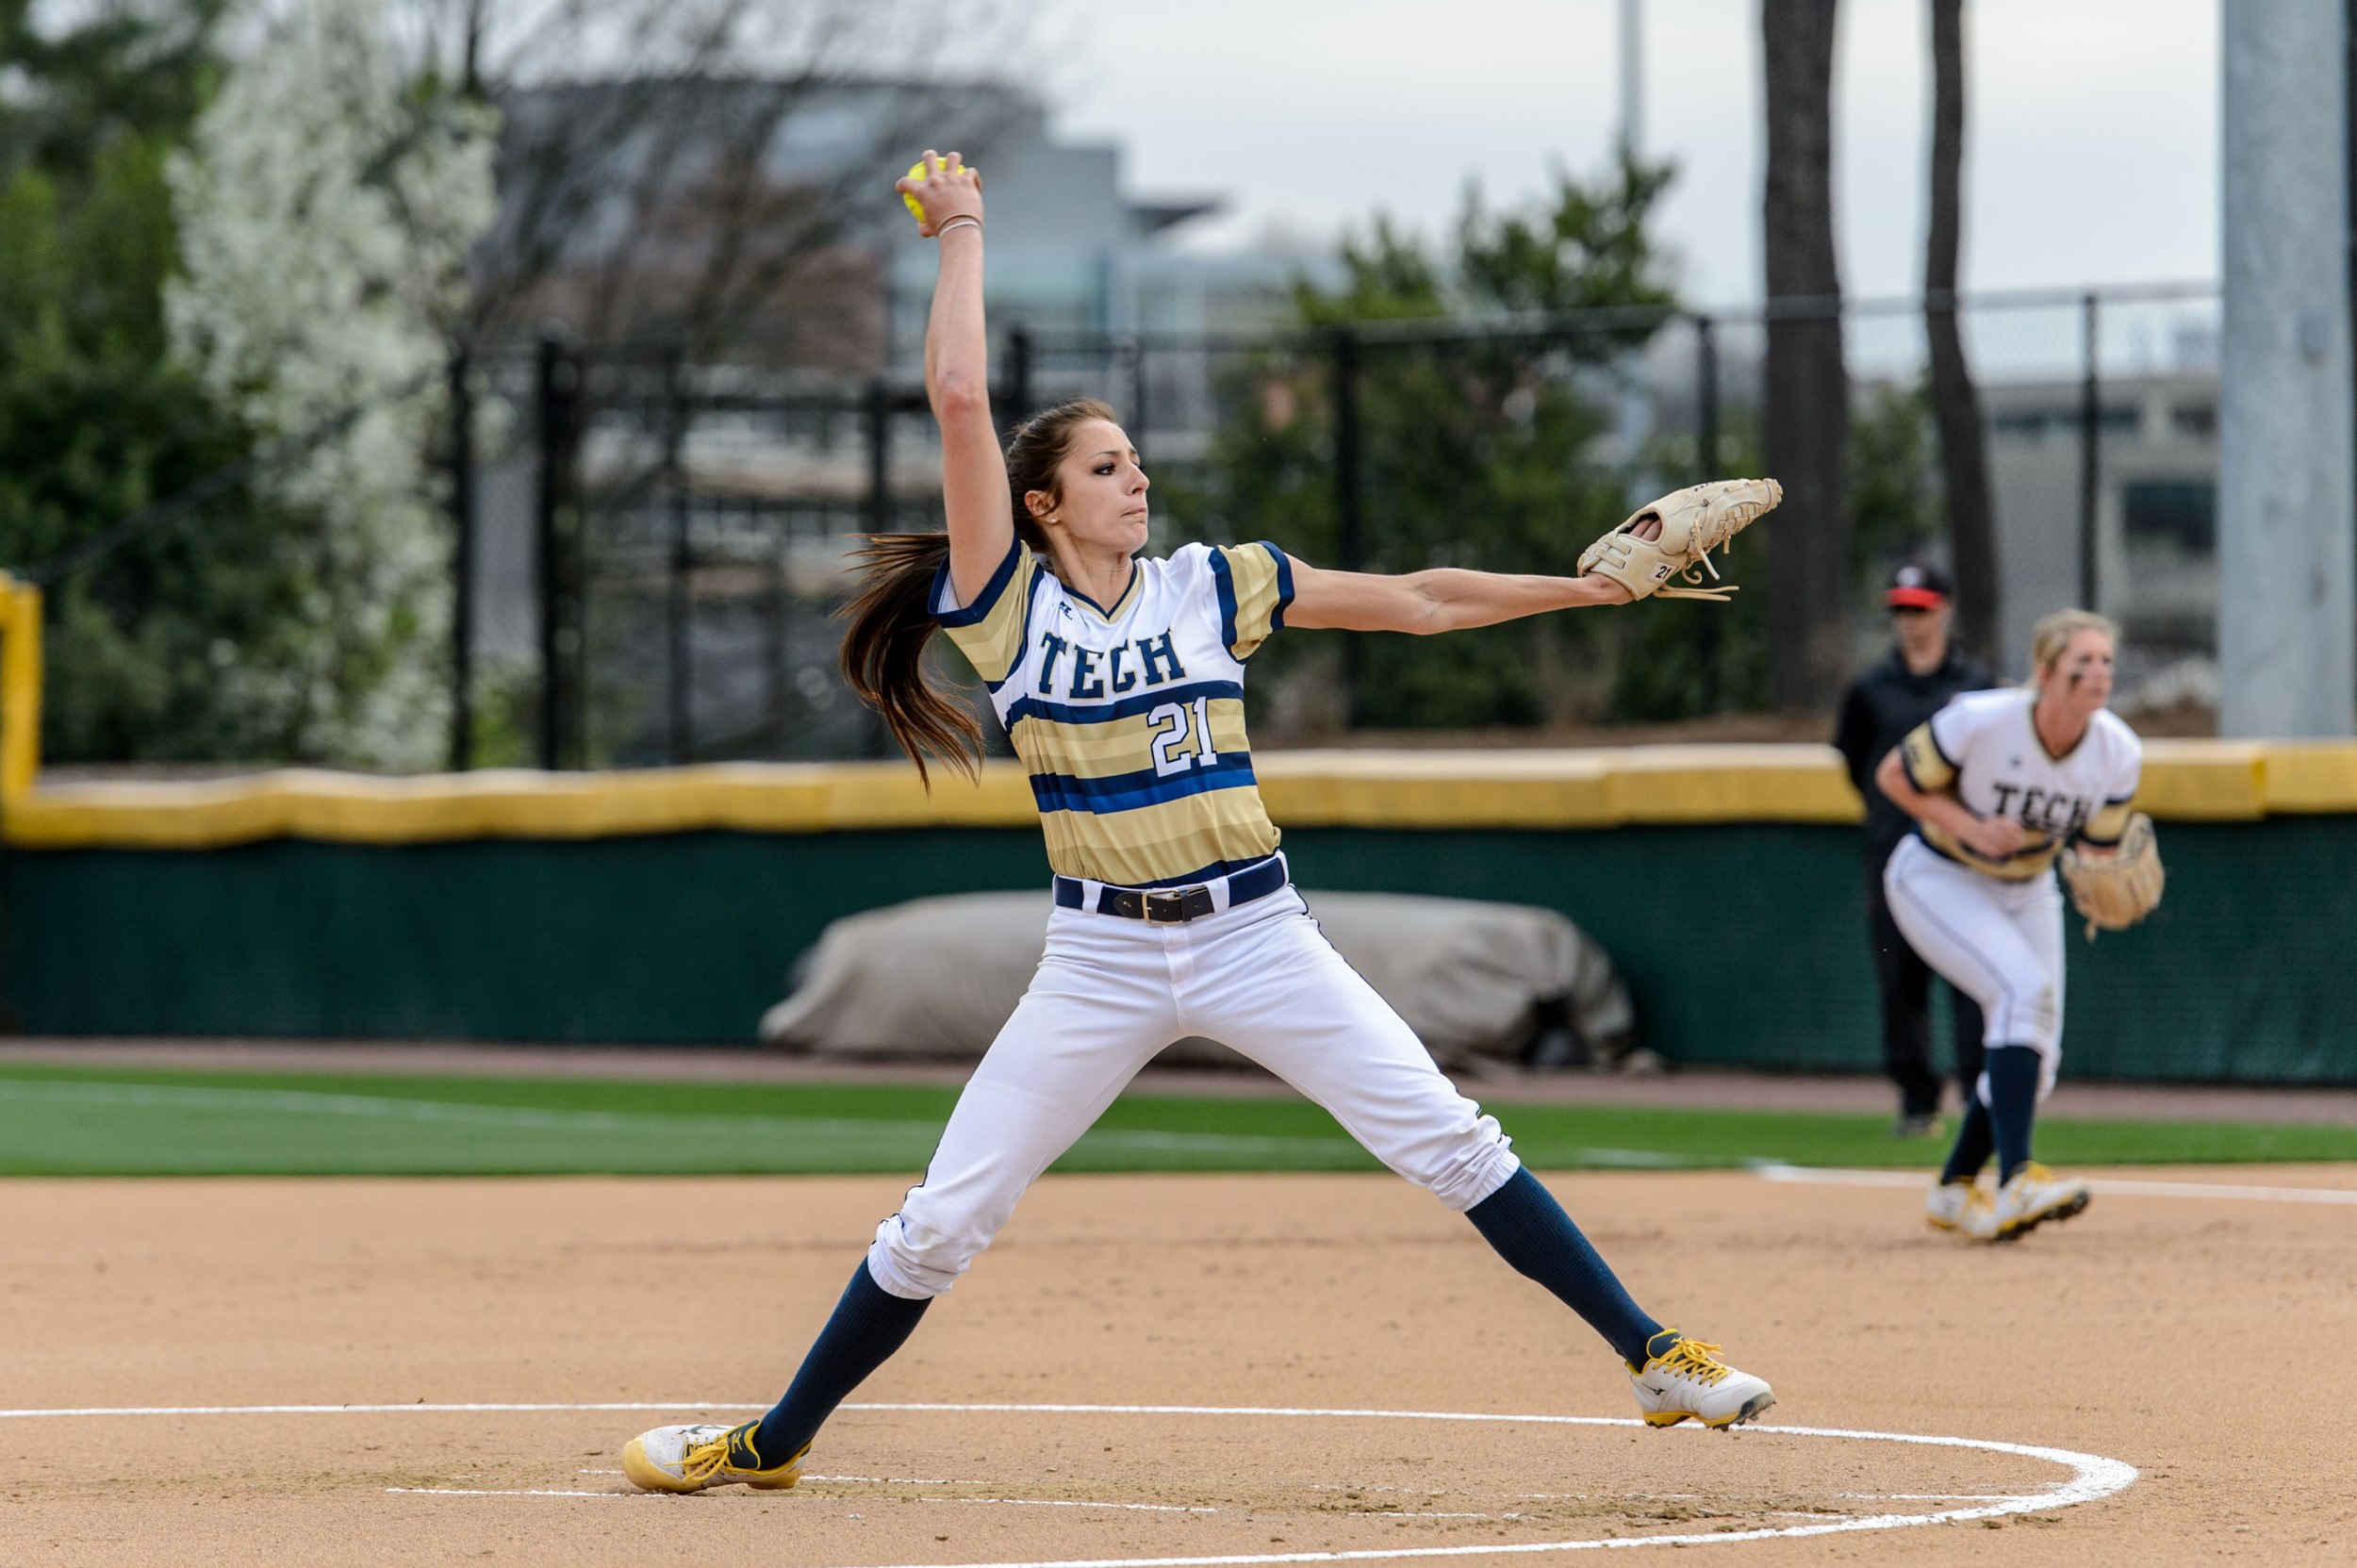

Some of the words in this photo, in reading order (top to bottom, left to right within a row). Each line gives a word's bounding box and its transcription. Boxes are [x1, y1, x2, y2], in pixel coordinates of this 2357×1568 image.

[1655, 565, 1673, 580] 21
[1039, 625, 1187, 700] TECH
[1146, 696, 1218, 778] 21
[1992, 782, 2092, 831] TECH
